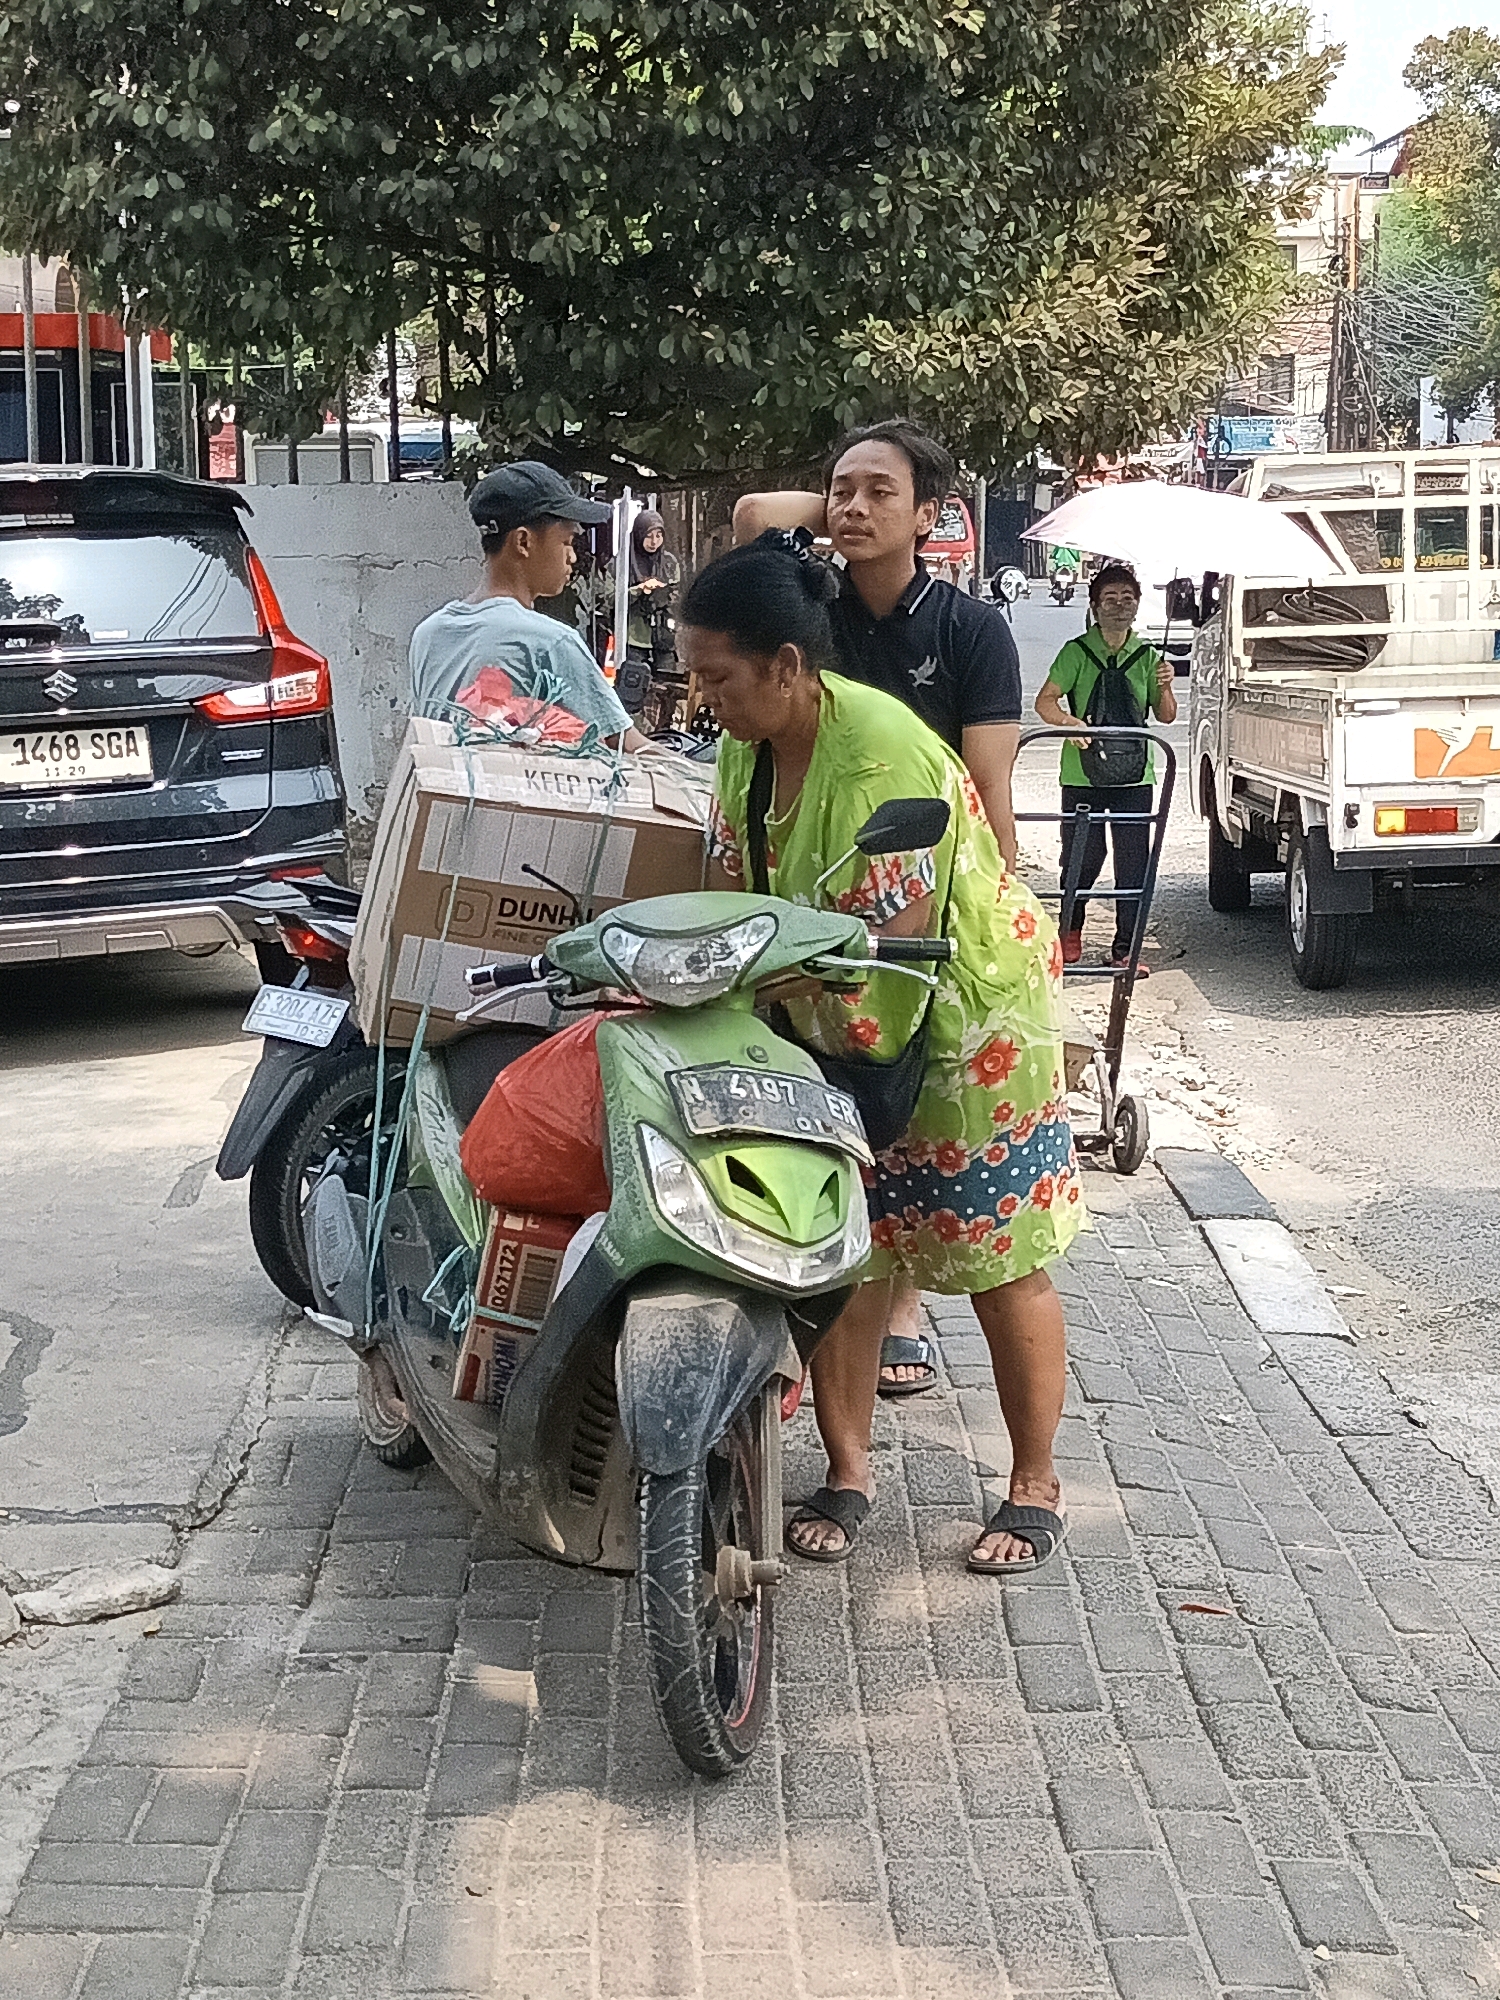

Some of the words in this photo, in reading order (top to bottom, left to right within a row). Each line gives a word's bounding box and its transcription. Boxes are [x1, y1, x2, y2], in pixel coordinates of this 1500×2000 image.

[13, 734, 81, 766] 1468
[90, 730, 140, 760] SGA
[524, 768, 582, 797] KEEP
[492, 929, 529, 944] FINE
[270, 994, 310, 1020] 3204
[729, 1073, 796, 1106] 4197
[823, 1092, 859, 1127] ER
[491, 1243, 517, 1308] 067172
